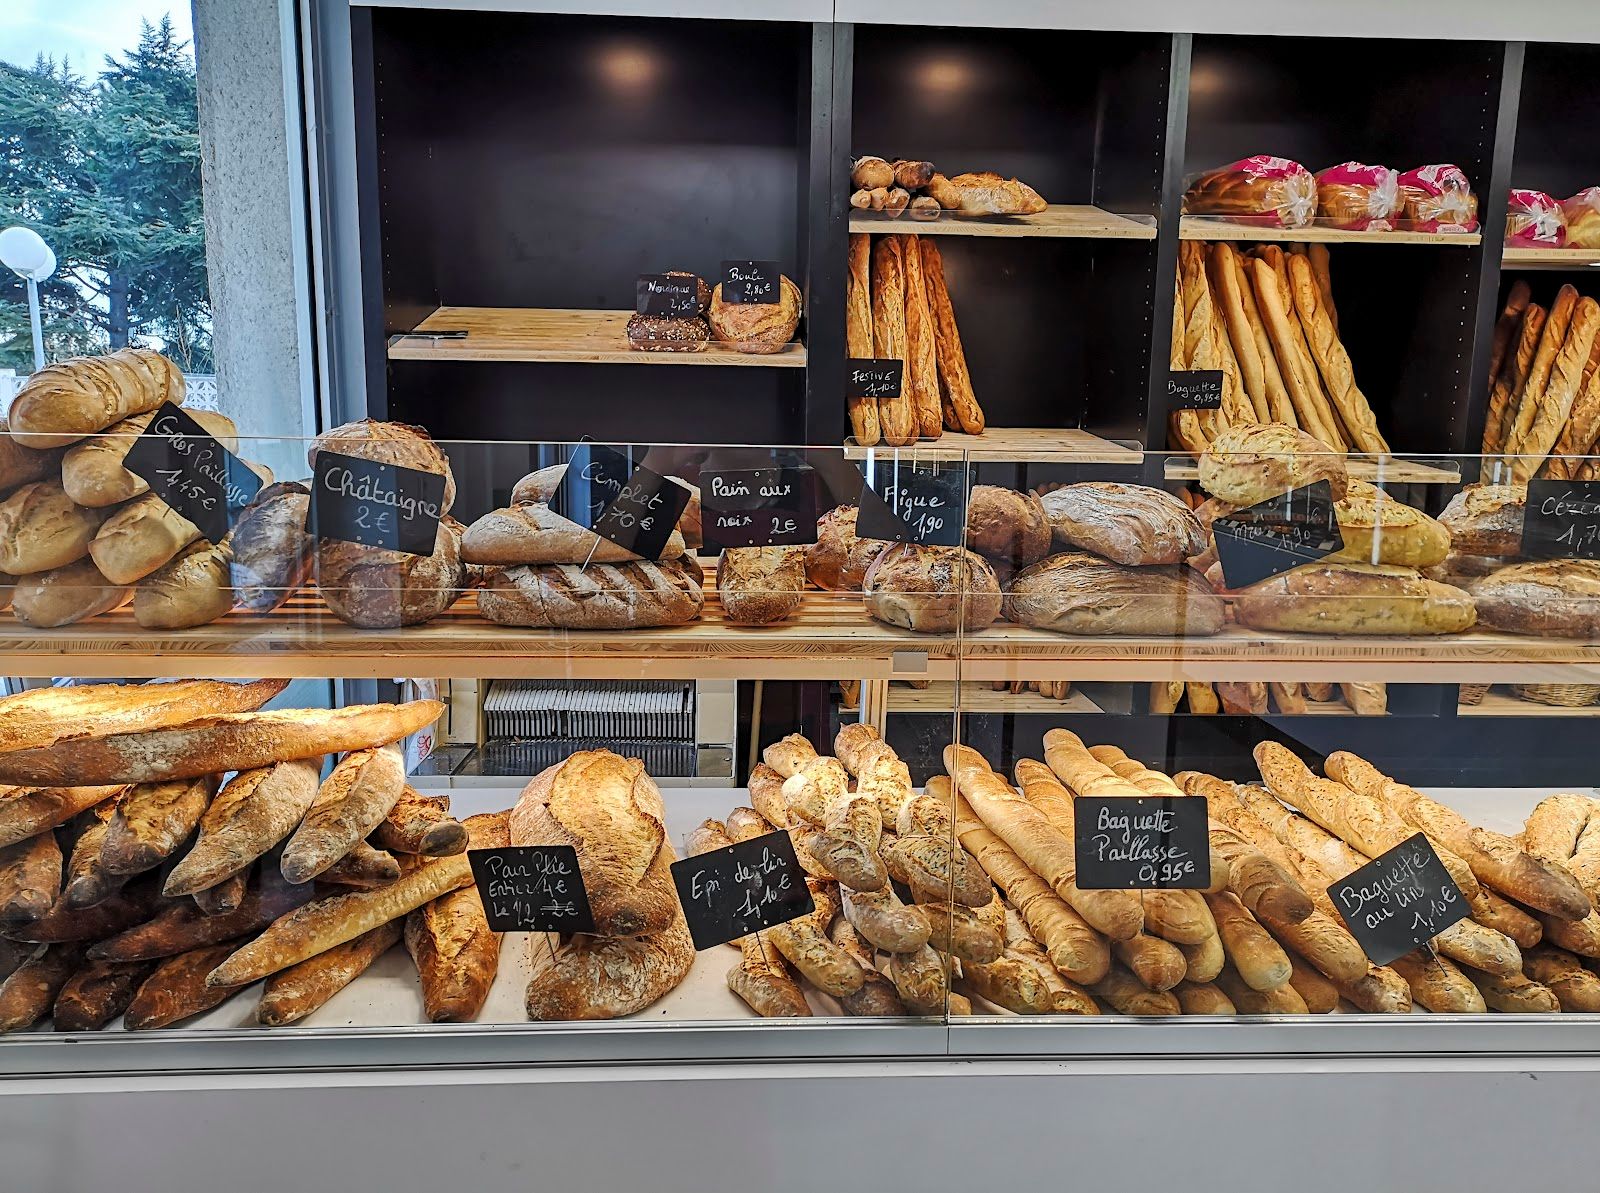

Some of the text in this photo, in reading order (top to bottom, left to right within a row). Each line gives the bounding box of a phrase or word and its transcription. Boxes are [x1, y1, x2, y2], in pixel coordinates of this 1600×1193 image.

[324, 466, 442, 521] Châtaigne
[711, 476, 791, 497] Pain aux
[883, 486, 946, 522] Figue
[912, 513, 944, 541] 1,90
[1097, 806, 1179, 845] Baguette
[1091, 833, 1189, 863] Paillasse
[1138, 860, 1195, 882] 0,95€
[1339, 851, 1431, 918] Baguette
